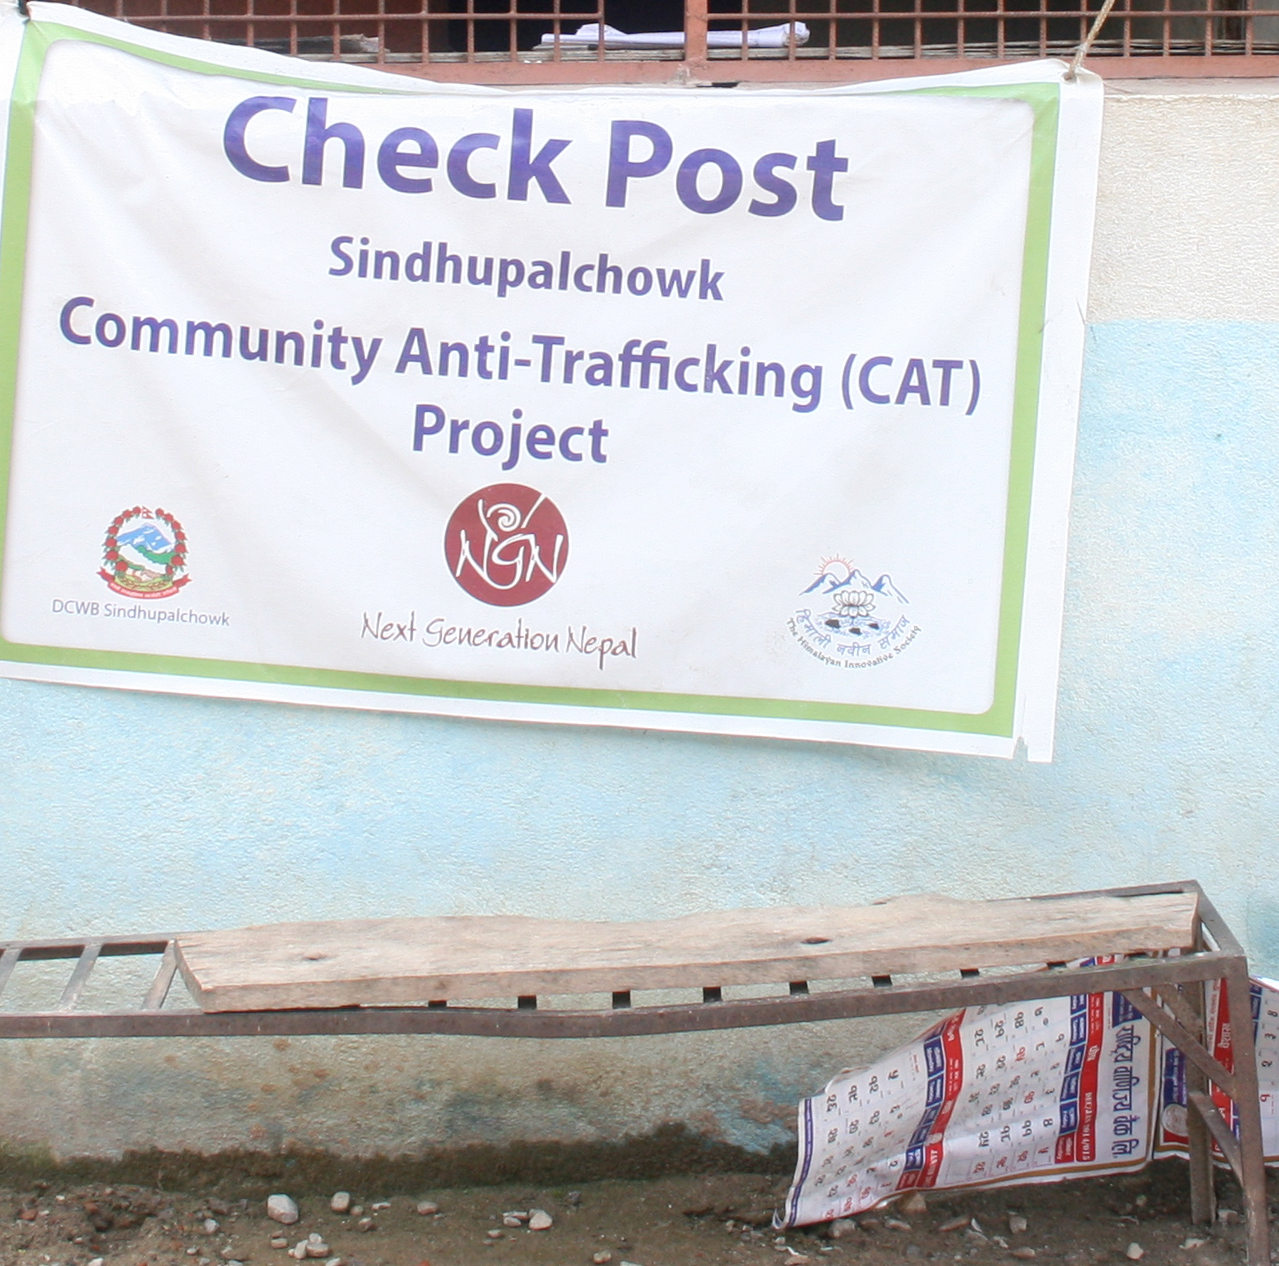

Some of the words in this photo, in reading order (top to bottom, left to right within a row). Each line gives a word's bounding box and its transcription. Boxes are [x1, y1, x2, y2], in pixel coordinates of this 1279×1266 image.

[222, 93, 573, 206] Check
[604, 116, 850, 223] Post
[328, 234, 725, 302] Sindhupalchowk
[58, 295, 381, 387] Community
[393, 325, 824, 414] Anti-Trafficking
[839, 351, 982, 417] (CAT)
[411, 401, 610, 473] Project
[52, 599, 99, 616] DCWB
[104, 603, 230, 627] Sindhupalchowk
[361, 610, 417, 642] Next
[422, 618, 559, 653] Generation
[565, 625, 639, 670] Nepal
